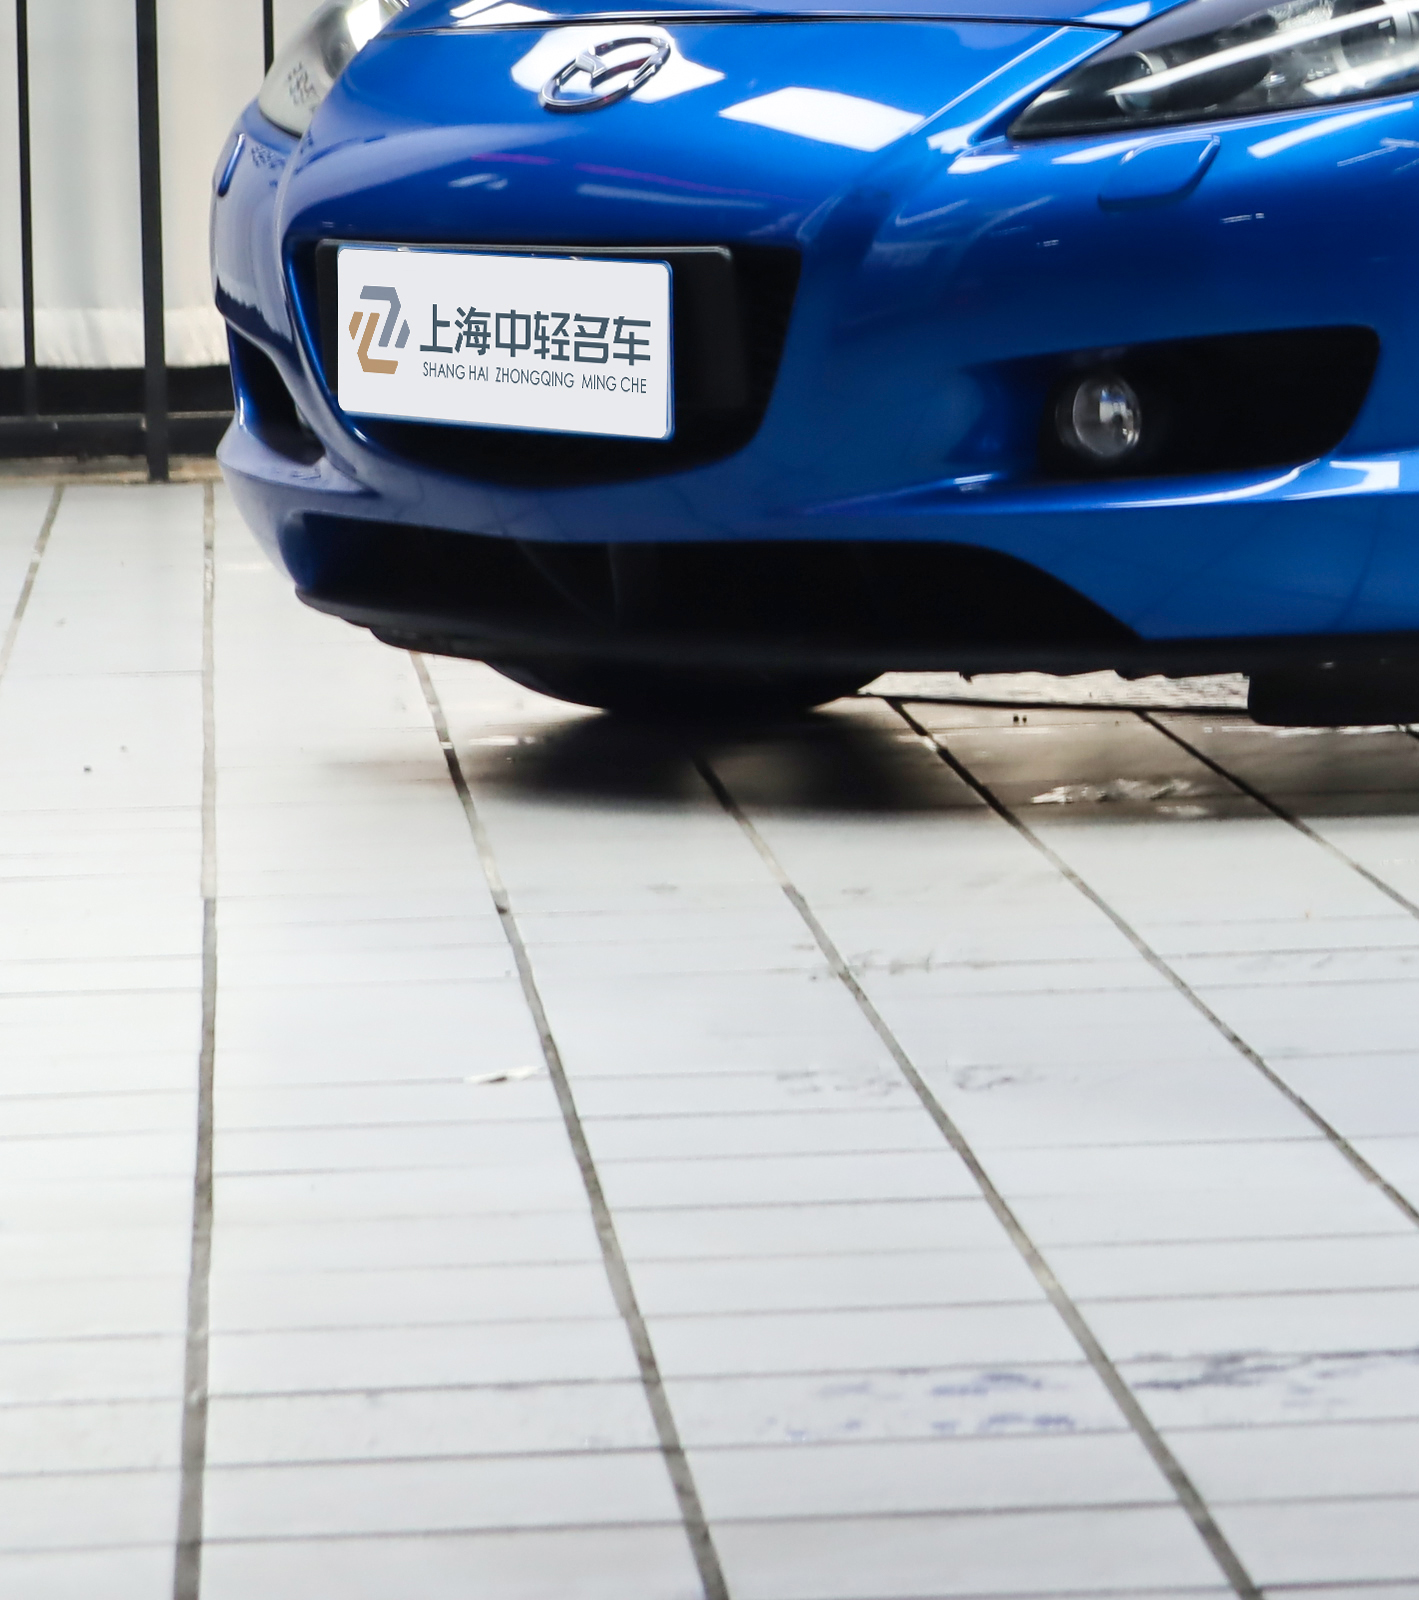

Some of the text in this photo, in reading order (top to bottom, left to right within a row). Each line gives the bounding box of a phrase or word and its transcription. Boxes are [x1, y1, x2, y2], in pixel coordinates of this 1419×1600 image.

[419, 303, 651, 367] 上海中轻名车
[422, 361, 647, 394] SHANG HAI ZHONGQING MING CHE
